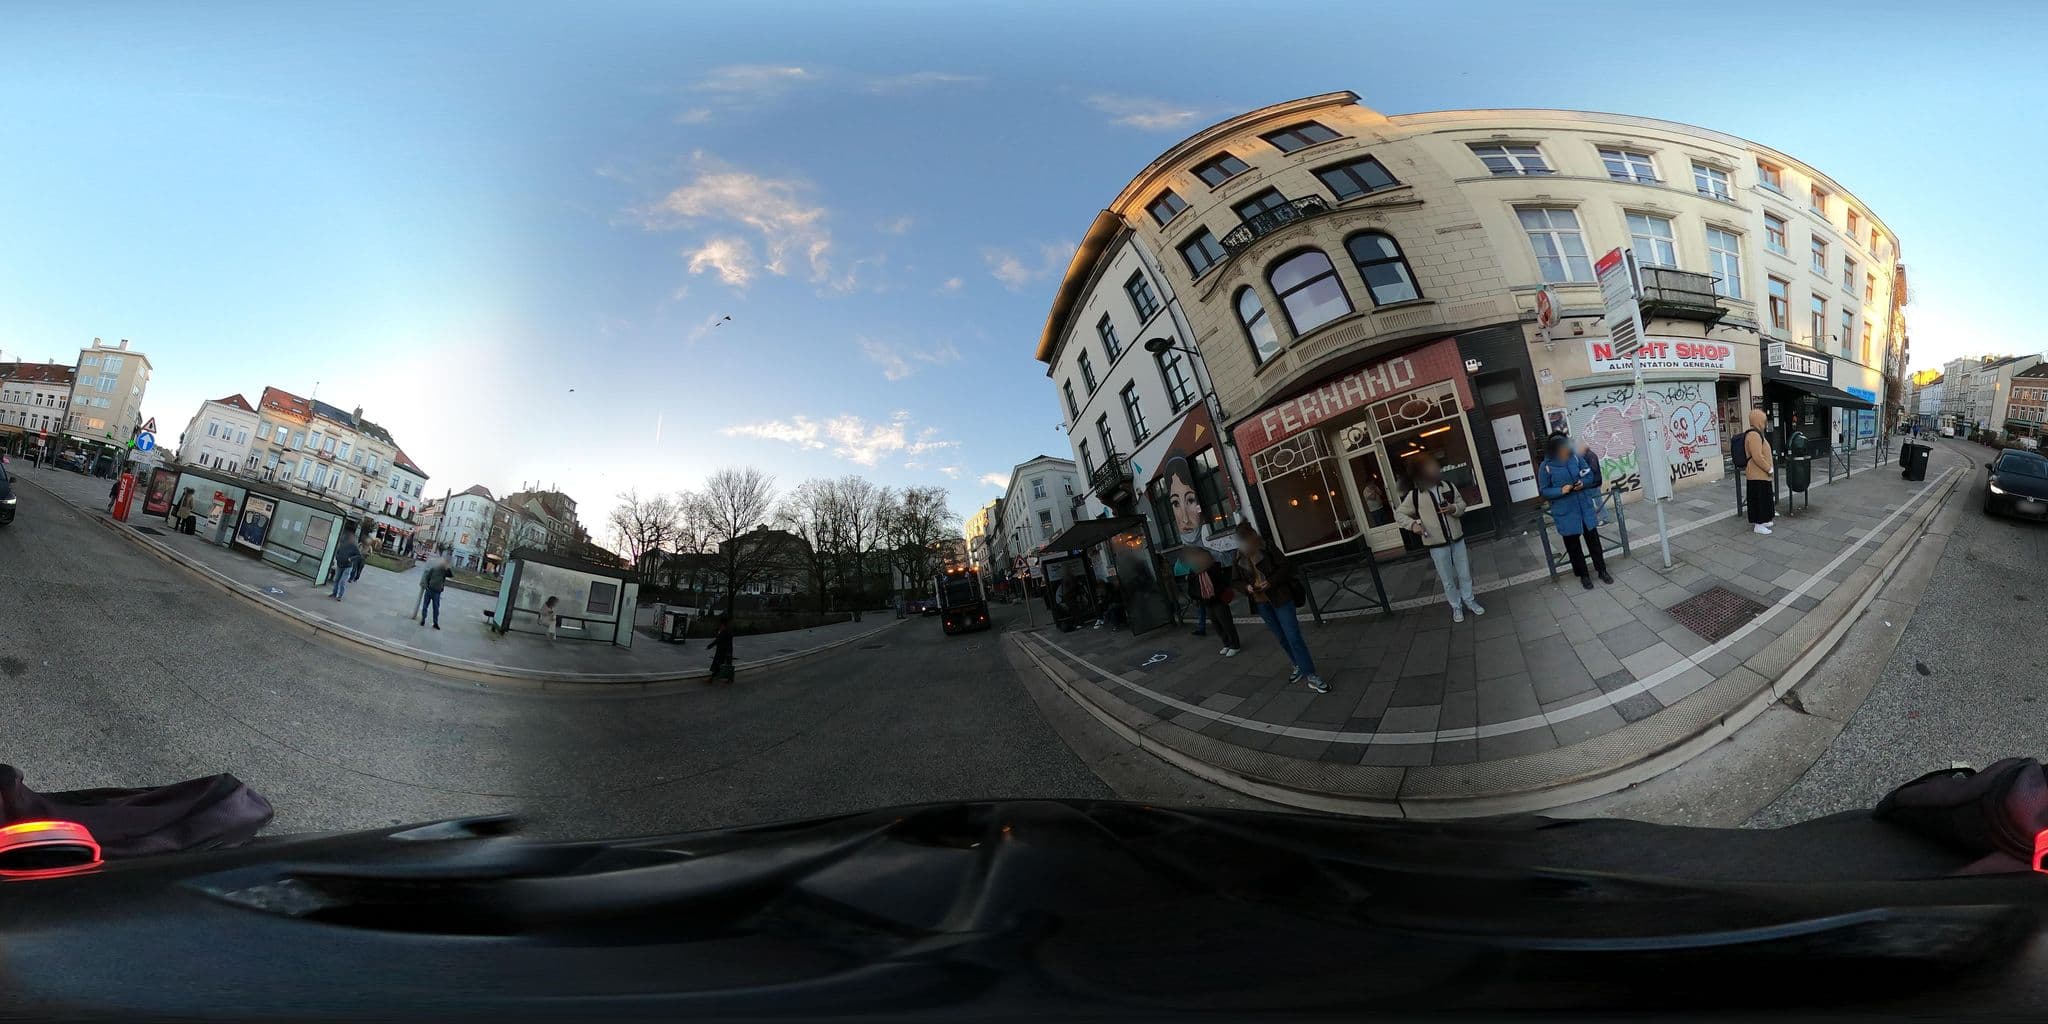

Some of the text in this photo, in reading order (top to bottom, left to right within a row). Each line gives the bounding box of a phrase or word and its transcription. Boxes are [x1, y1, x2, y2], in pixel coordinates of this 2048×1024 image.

[1592, 342, 1730, 361] NHT SHOP
[1609, 361, 1724, 370] ALIMNTATION GENERALE
[1260, 356, 1415, 441] FERNAND
